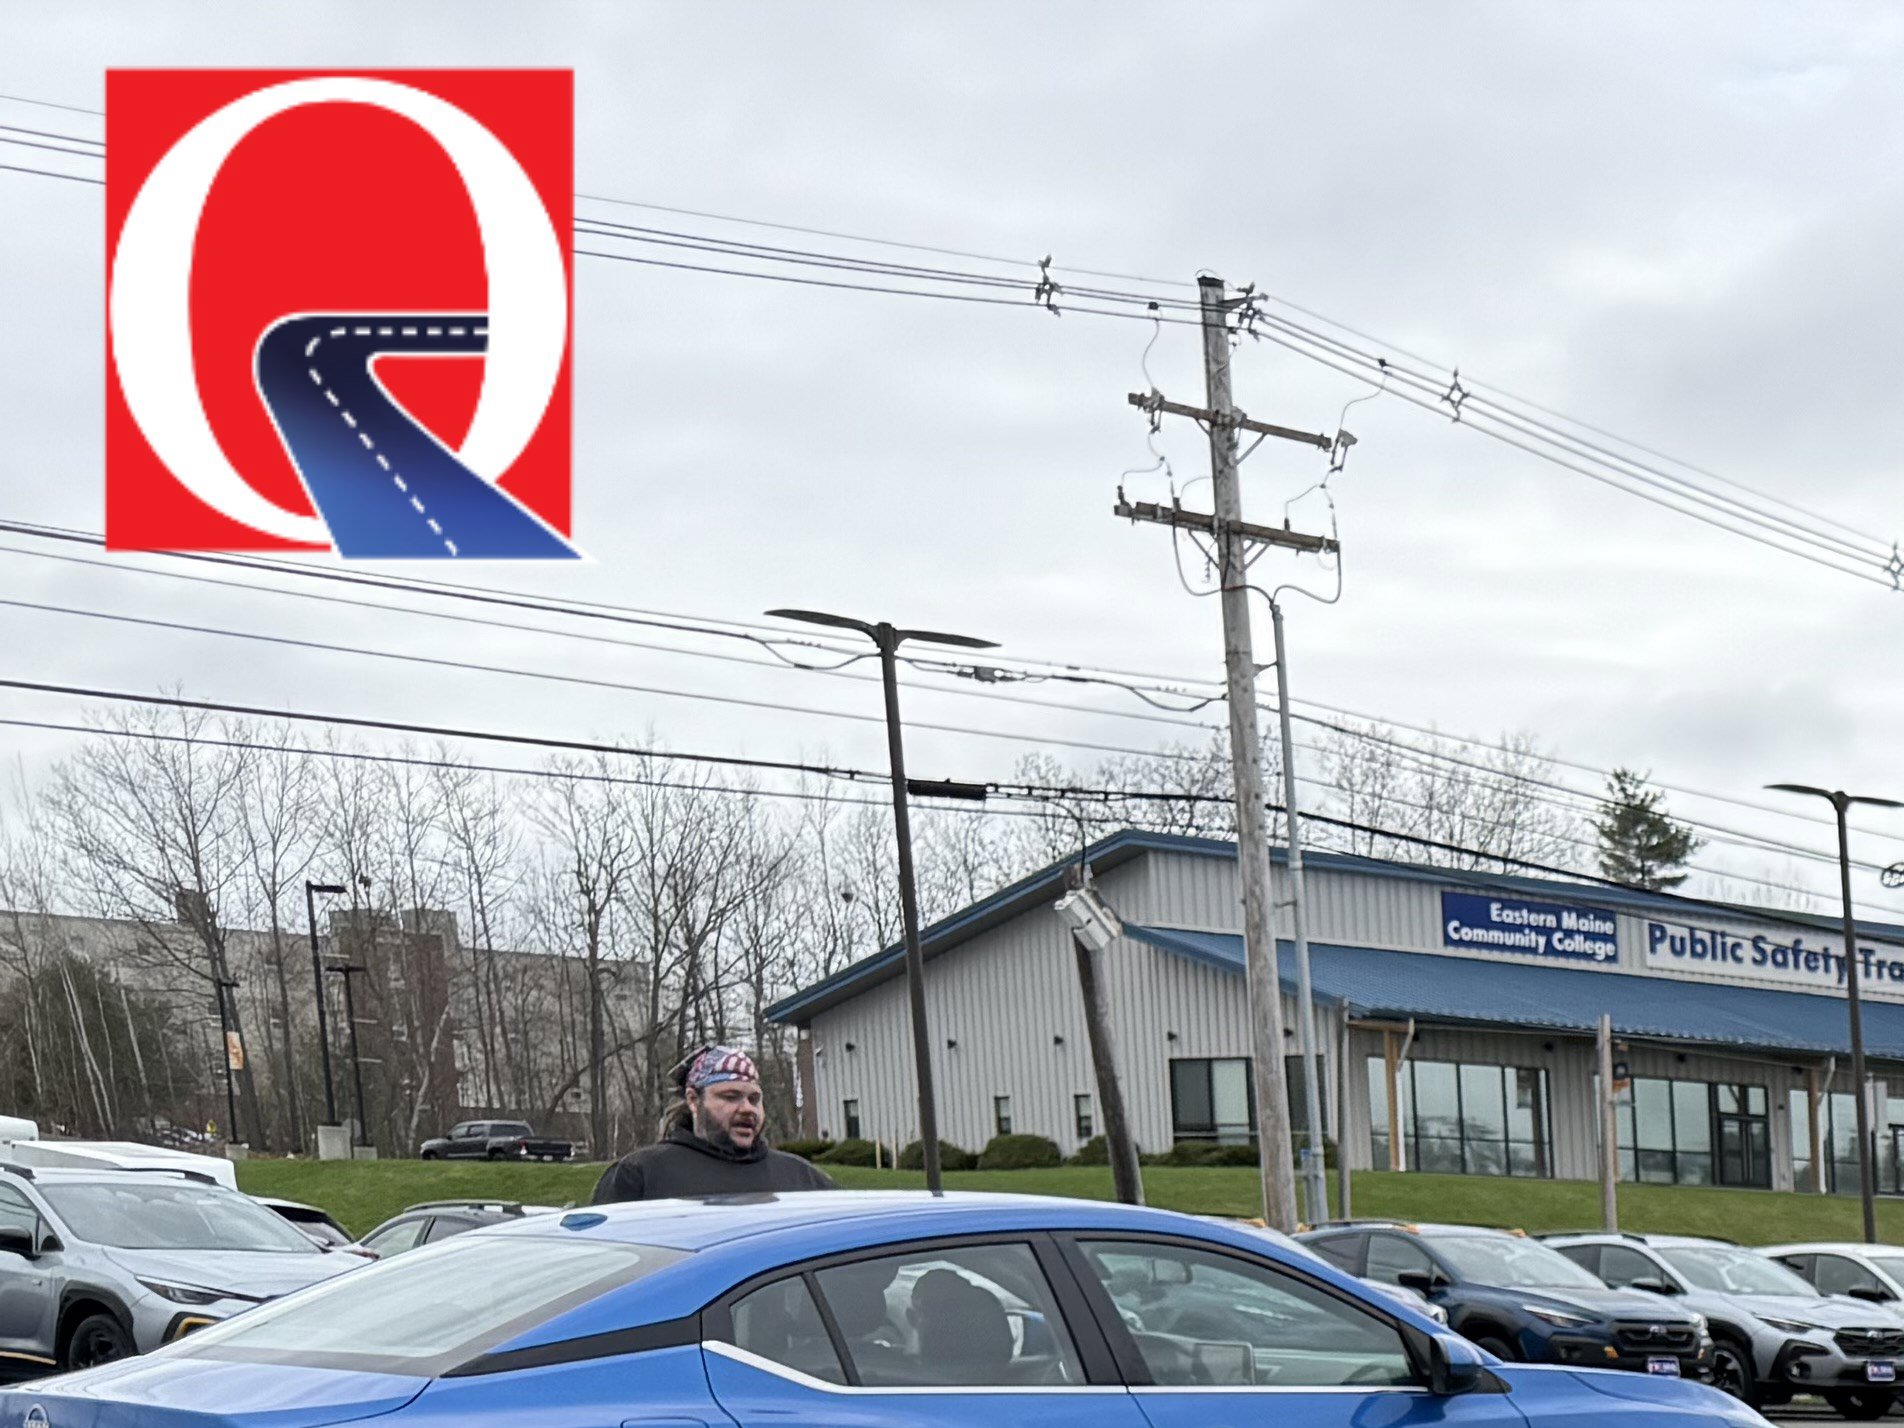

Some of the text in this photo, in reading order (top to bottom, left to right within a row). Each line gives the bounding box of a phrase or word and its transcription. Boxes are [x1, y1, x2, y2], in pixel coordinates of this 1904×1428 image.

[1490, 902, 1615, 935] Eastern Maine
[1447, 920, 1616, 961] Community College
[1648, 922, 1744, 963] Public
[1751, 935, 1848, 985] Safety
